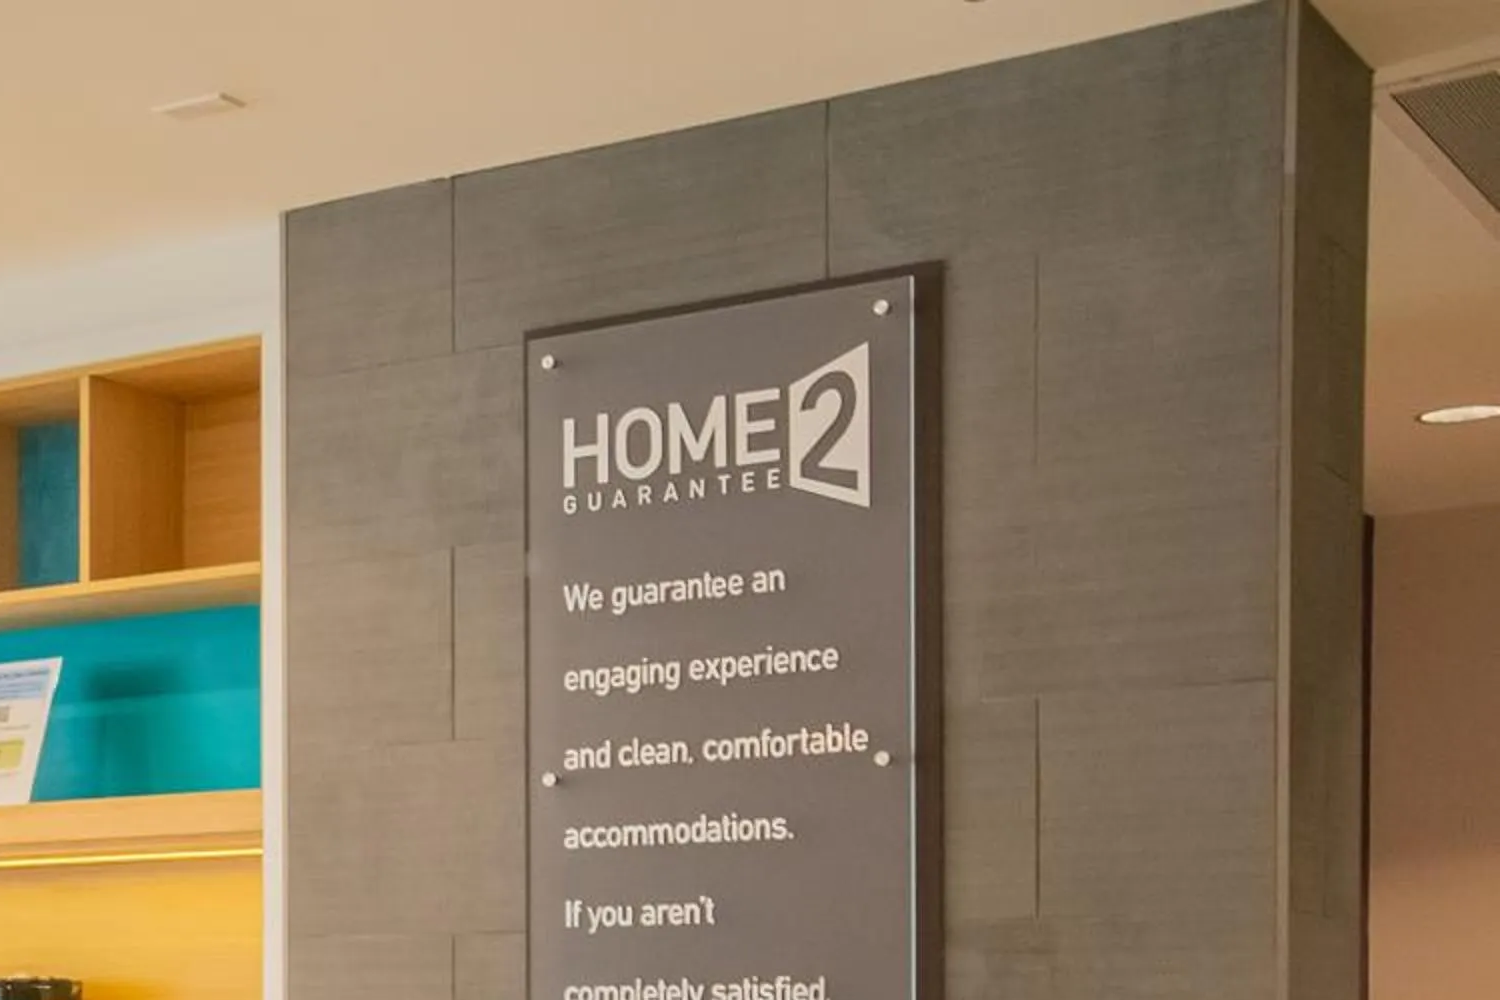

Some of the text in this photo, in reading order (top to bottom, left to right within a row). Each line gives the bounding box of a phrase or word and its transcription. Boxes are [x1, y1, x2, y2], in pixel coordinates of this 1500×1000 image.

[563, 469, 781, 515] GUARANTEE
[562, 568, 787, 616] We guarantee an
[563, 645, 840, 697] engaging experience
[563, 739, 611, 771] and
[701, 722, 870, 763] comfortable
[563, 812, 795, 850] accommodations.
[564, 895, 716, 935] If you aren't
